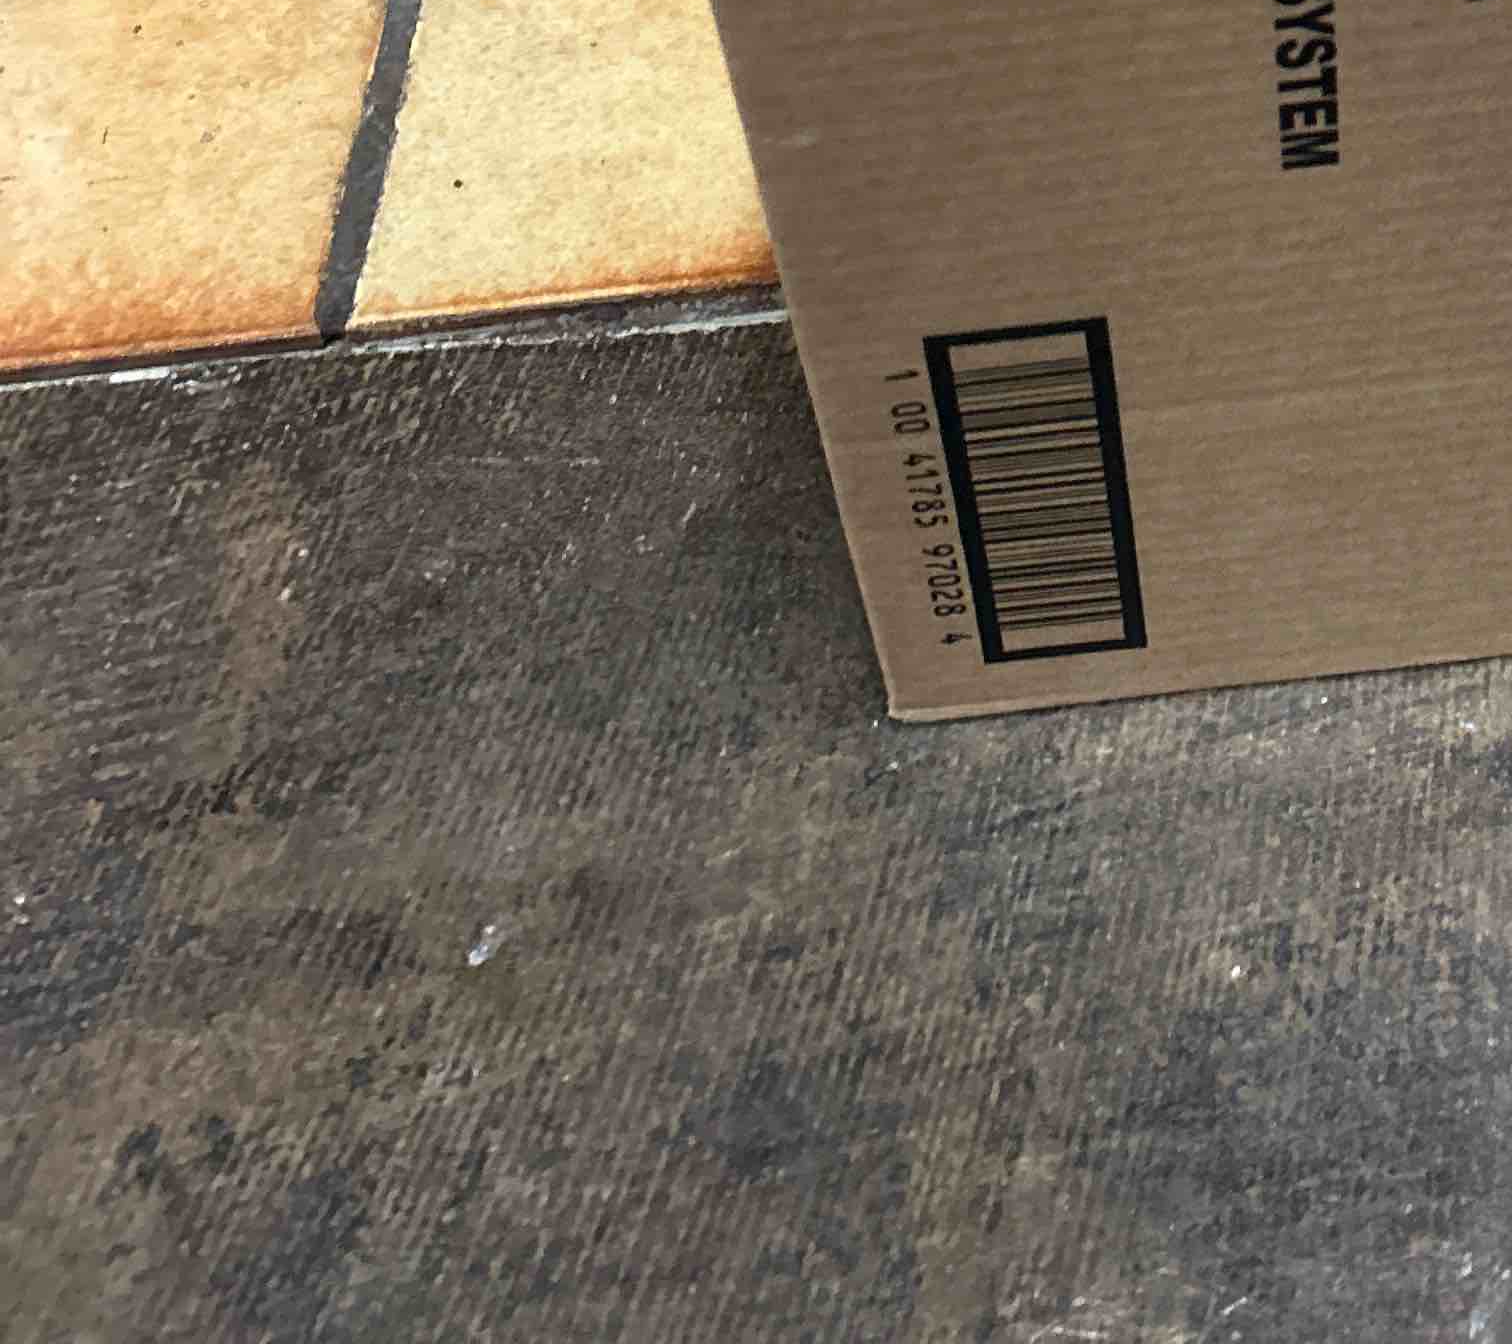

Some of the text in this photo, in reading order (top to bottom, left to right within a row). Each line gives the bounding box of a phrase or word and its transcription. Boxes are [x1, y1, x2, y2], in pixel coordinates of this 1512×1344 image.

[884, 369, 973, 645] 1 00 41785 97028 4
